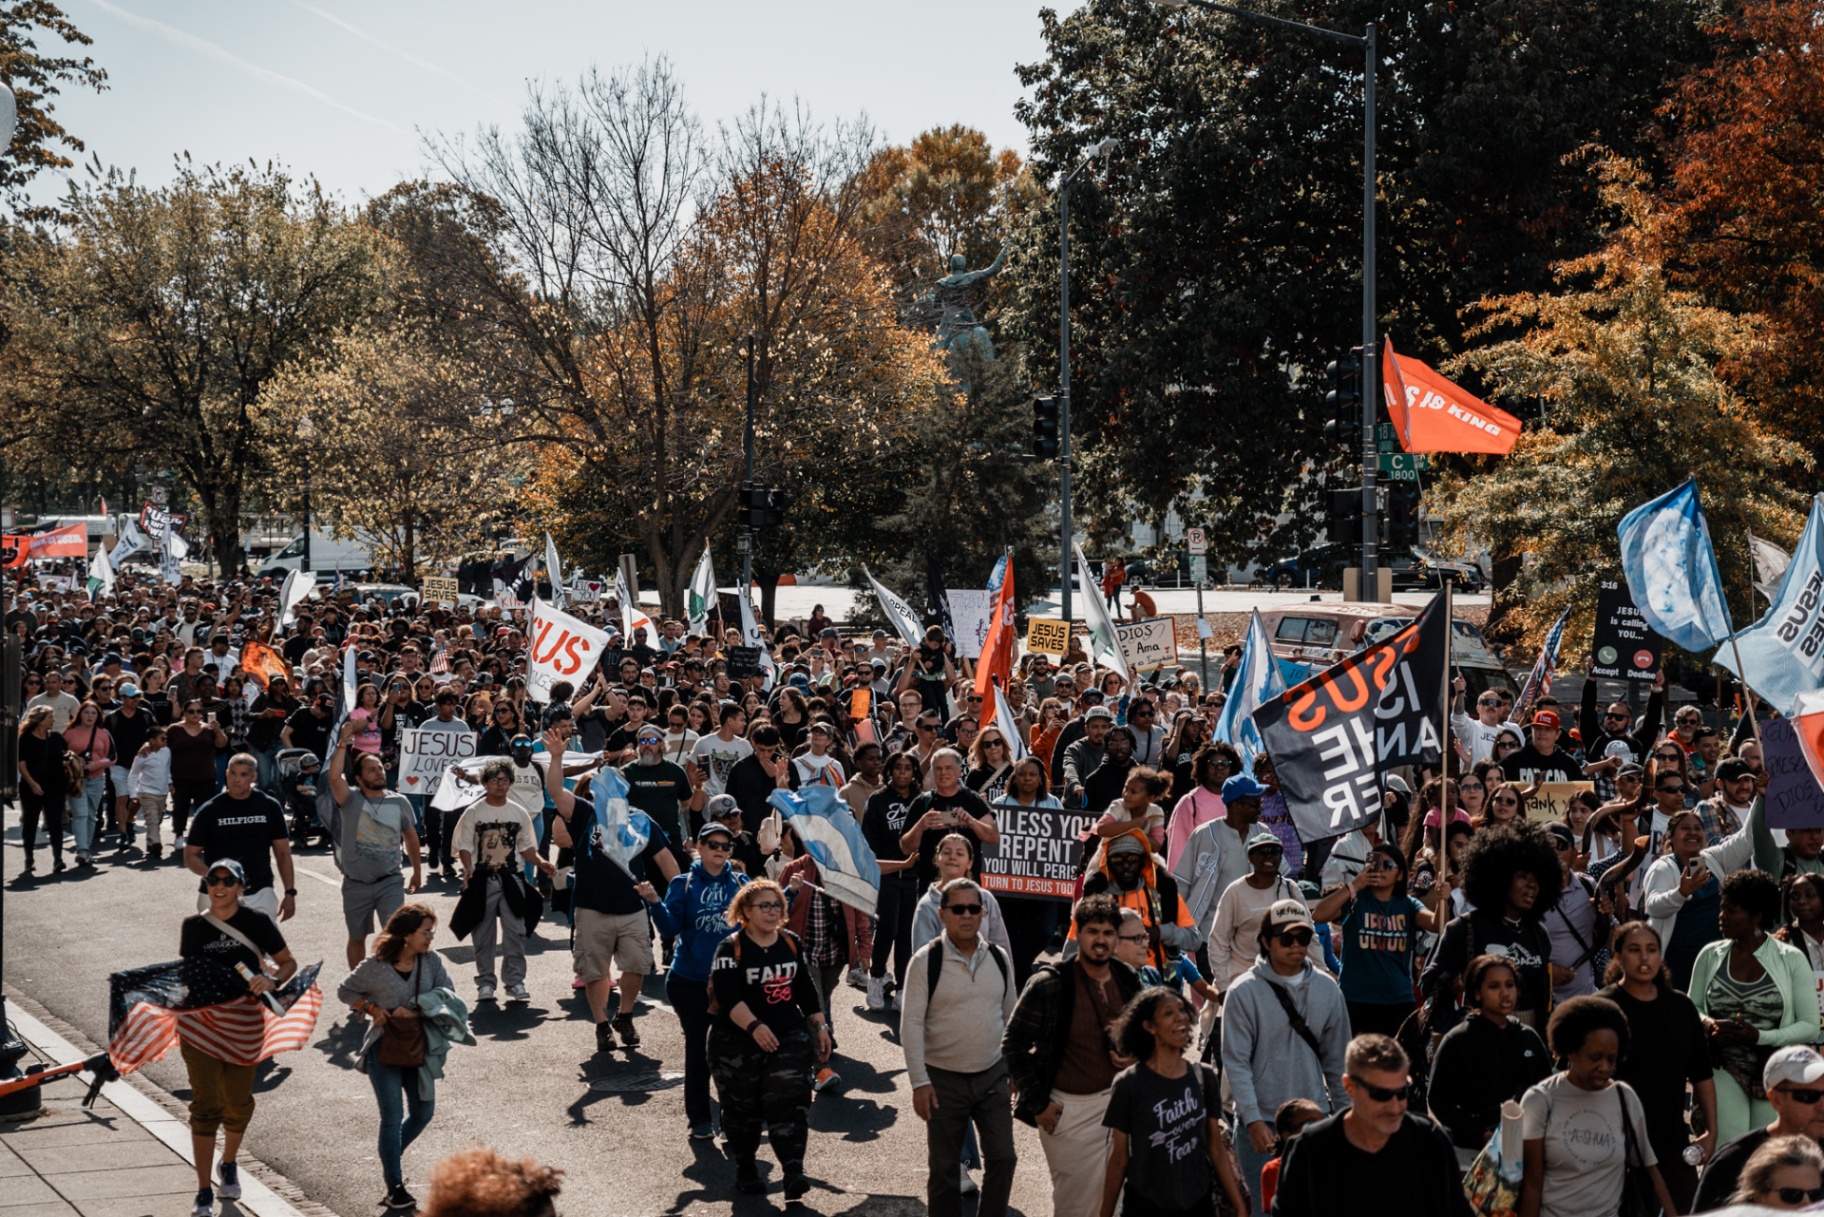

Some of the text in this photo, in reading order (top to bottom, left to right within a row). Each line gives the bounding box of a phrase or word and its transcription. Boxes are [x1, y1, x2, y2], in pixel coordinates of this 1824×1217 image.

[1447, 404, 1502, 436] KING
[1391, 455, 1404, 470] C
[1390, 470, 1416, 480] 1800
[426, 578, 456, 591] JESUS
[1601, 580, 1618, 590] 3:16
[425, 590, 457, 600] SAVES
[1616, 606, 1641, 616] JESU
[1032, 623, 1066, 638] JESUS
[1622, 616, 1648, 632] calling
[1030, 636, 1064, 650] SAVES
[1136, 642, 1160, 654] Ama
[1592, 666, 1619, 677] Accept
[1627, 670, 1656, 680] Decline
[404, 732, 475, 757] JESUS
[218, 814, 267, 826] HILFIGER
[998, 834, 1074, 864] REPENT
[984, 858, 1078, 880] YOU WILL PERIS
[984, 875, 1075, 895] TURN TO JESUS TOD
[1153, 1087, 1198, 1129] Faith
[1165, 1136, 1199, 1164] Fear
